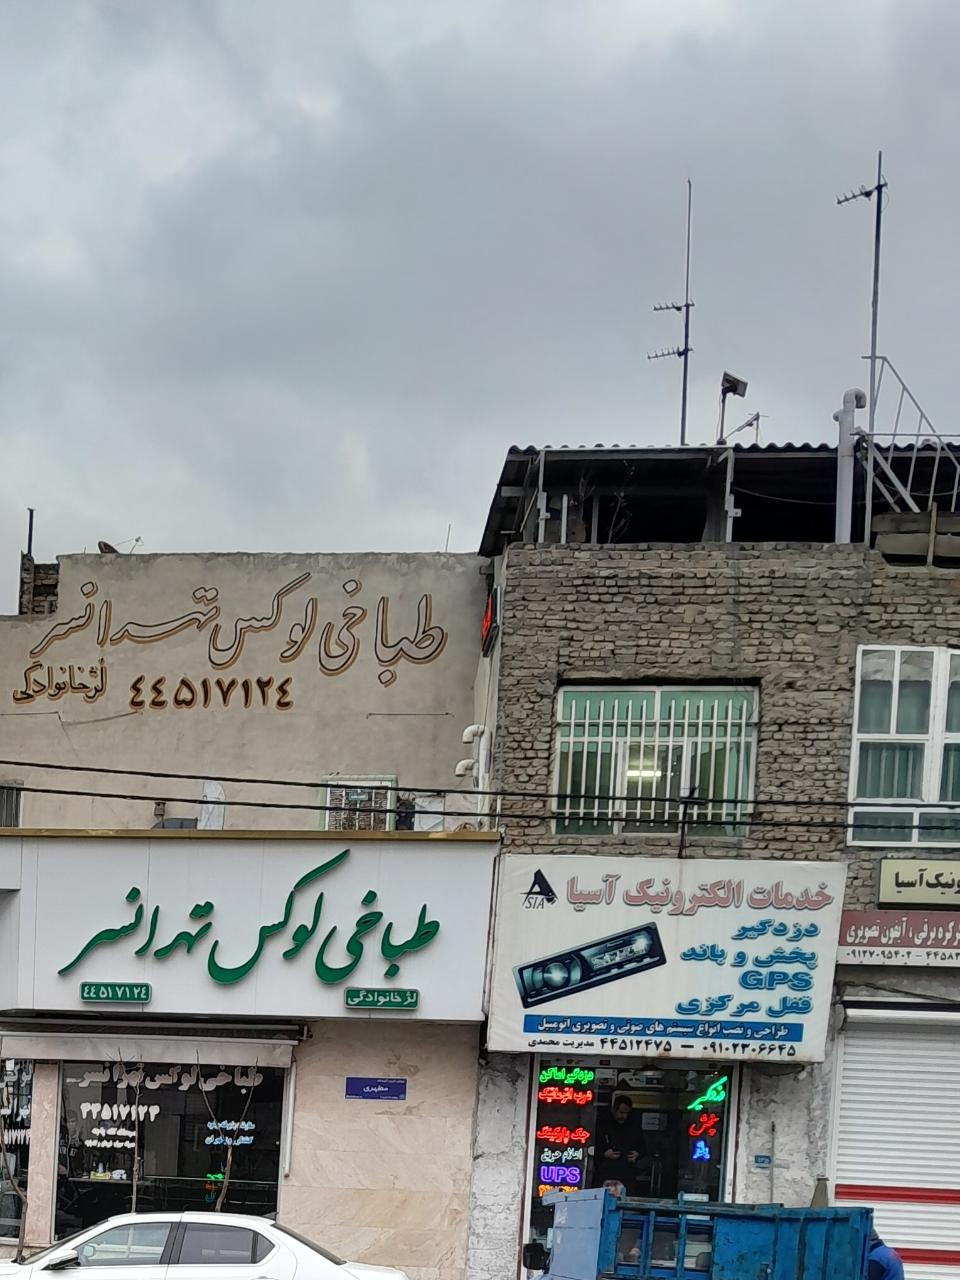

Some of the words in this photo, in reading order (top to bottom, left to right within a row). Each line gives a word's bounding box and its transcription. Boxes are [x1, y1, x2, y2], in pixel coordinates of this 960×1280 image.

[30, 581, 221, 659] تهرانسر
[208, 571, 319, 670] لوکس
[318, 578, 448, 688] طباخی
[895, 867, 928, 894] آسیا
[567, 873, 622, 912] آسیا
[623, 878, 744, 916] الکترونیک
[747, 880, 835, 910] خدمات
[207, 848, 351, 985] لوکس
[57, 886, 214, 976] تهرانسر
[315, 889, 440, 985] طباخی
[731, 919, 820, 941] دزدگیر
[846, 920, 880, 944] تصویری
[880, 917, 908, 944] آیفون
[680, 944, 726, 966] باند
[730, 950, 748, 967] و
[752, 946, 818, 970] پخش
[738, 970, 814, 991] GPS
[347, 990, 402, 1006] خانوادگی
[403, 991, 417, 1005] لژ
[675, 994, 761, 1016] مرکزی
[766, 995, 813, 1017] قفل
[537, 1018, 571, 1031] اتومبیل
[572, 1020, 608, 1032] تصویری
[617, 1019, 644, 1034] صوتی
[645, 1020, 665, 1034] های
[666, 1022, 695, 1035] سیستم
[696, 1022, 721, 1037] انواع
[722, 1023, 744, 1035] نصب
[753, 1025, 789, 1039] طراحی
[528, 1038, 560, 1047] محمدی
[562, 1039, 594, 1049] مدیریت
[144, 1064, 199, 1091] لوکس
[198, 1064, 264, 1095] طباخی
[540, 1166, 581, 1184] UPS
